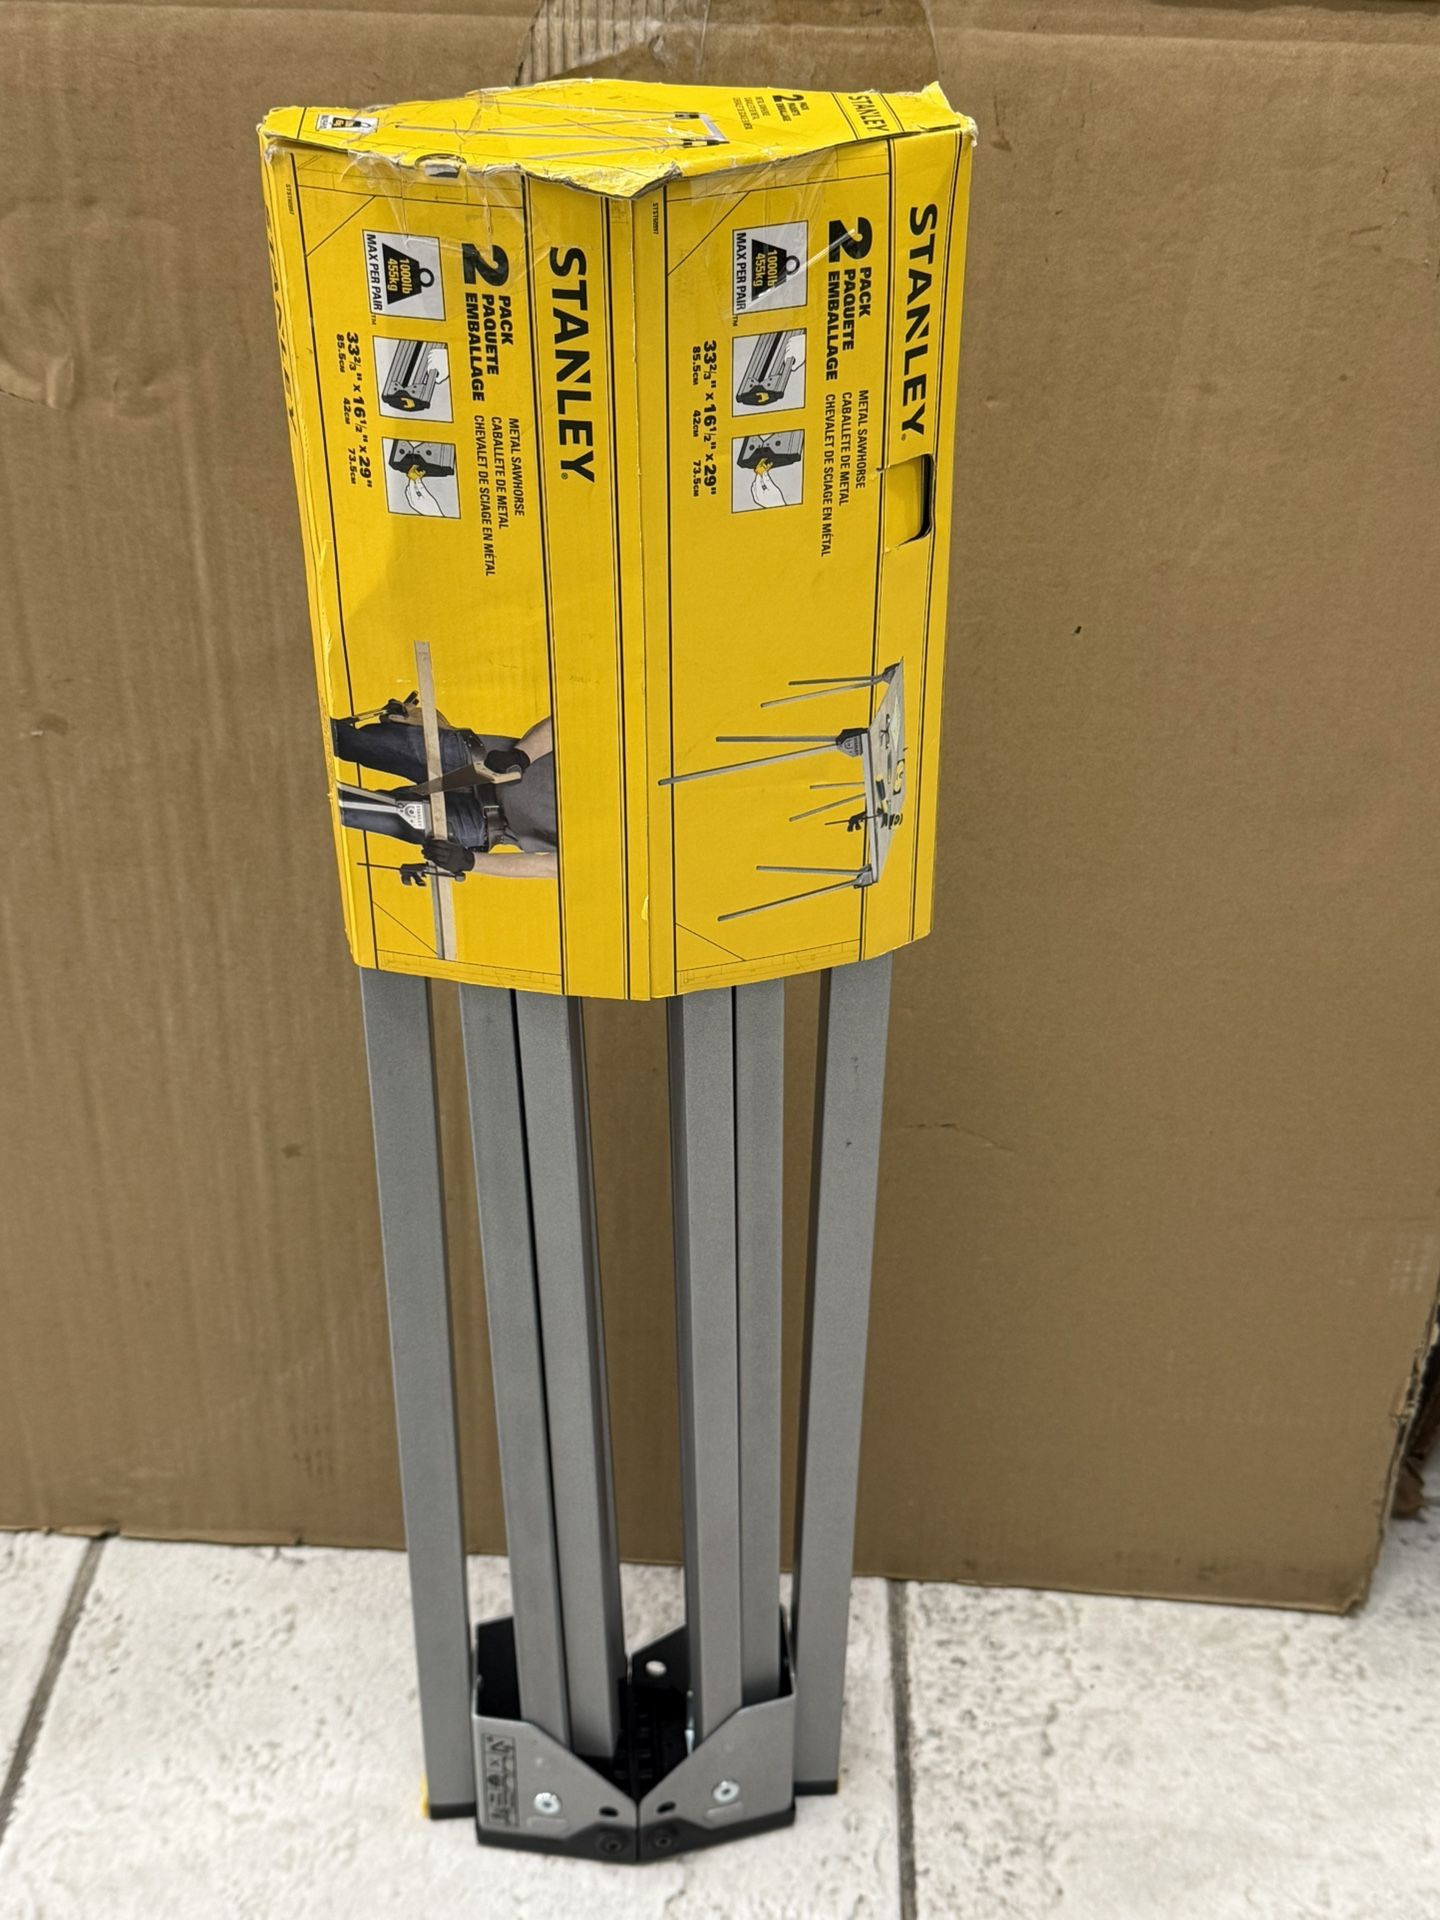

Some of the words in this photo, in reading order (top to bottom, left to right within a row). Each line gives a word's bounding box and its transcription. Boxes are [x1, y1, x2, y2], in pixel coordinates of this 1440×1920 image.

[848, 95, 890, 132] STANLEY
[366, 234, 377, 261] MAX
[736, 232, 746, 260] MAX
[829, 217, 872, 263] 2
[370, 263, 380, 284] PER
[387, 258, 398, 291] 455kg
[400, 258, 411, 294] 1000lb
[462, 243, 509, 287] 2
[737, 262, 746, 284] PER
[753, 253, 765, 286] 455kg
[767, 250, 778, 287] 1000lb
[372, 286, 382, 311] PAIR
[736, 286, 746, 310] PAIR
[843, 269, 856, 350] PAQUETE
[859, 267, 872, 317] PACK
[482, 294, 498, 375] PAQUETE
[499, 296, 513, 345] PACK
[826, 271, 839, 380] EMBALLAGE
[901, 203, 938, 436] STANLEY
[465, 292, 484, 401] EMBALLAGE
[550, 246, 595, 483] STANLEY
[824, 394, 835, 448] CHEVALET
[841, 392, 852, 452] CABALLETE
[858, 390, 868, 426] METAL
[474, 415, 487, 469] CHEVALET
[492, 417, 505, 476] CABALLETE
[509, 418, 520, 454] METAL
[359, 456, 372, 488] 29"
[824, 451, 834, 464] DE
[840, 455, 850, 469] DE
[856, 429, 867, 489] SAWHORSE
[479, 471, 488, 484] DE
[496, 479, 506, 493] DE
[512, 457, 524, 516] SAWHORSE
[705, 464, 716, 495] 29"
[823, 467, 833, 504] SCIAGE
[839, 471, 849, 506] METAL
[479, 487, 492, 524] SCIAGE
[497, 495, 508, 529] METAL
[823, 507, 832, 521] EN
[483, 527, 492, 541] EN
[821, 524, 834, 557] MÉTAL
[484, 543, 497, 576] MÉTAL
